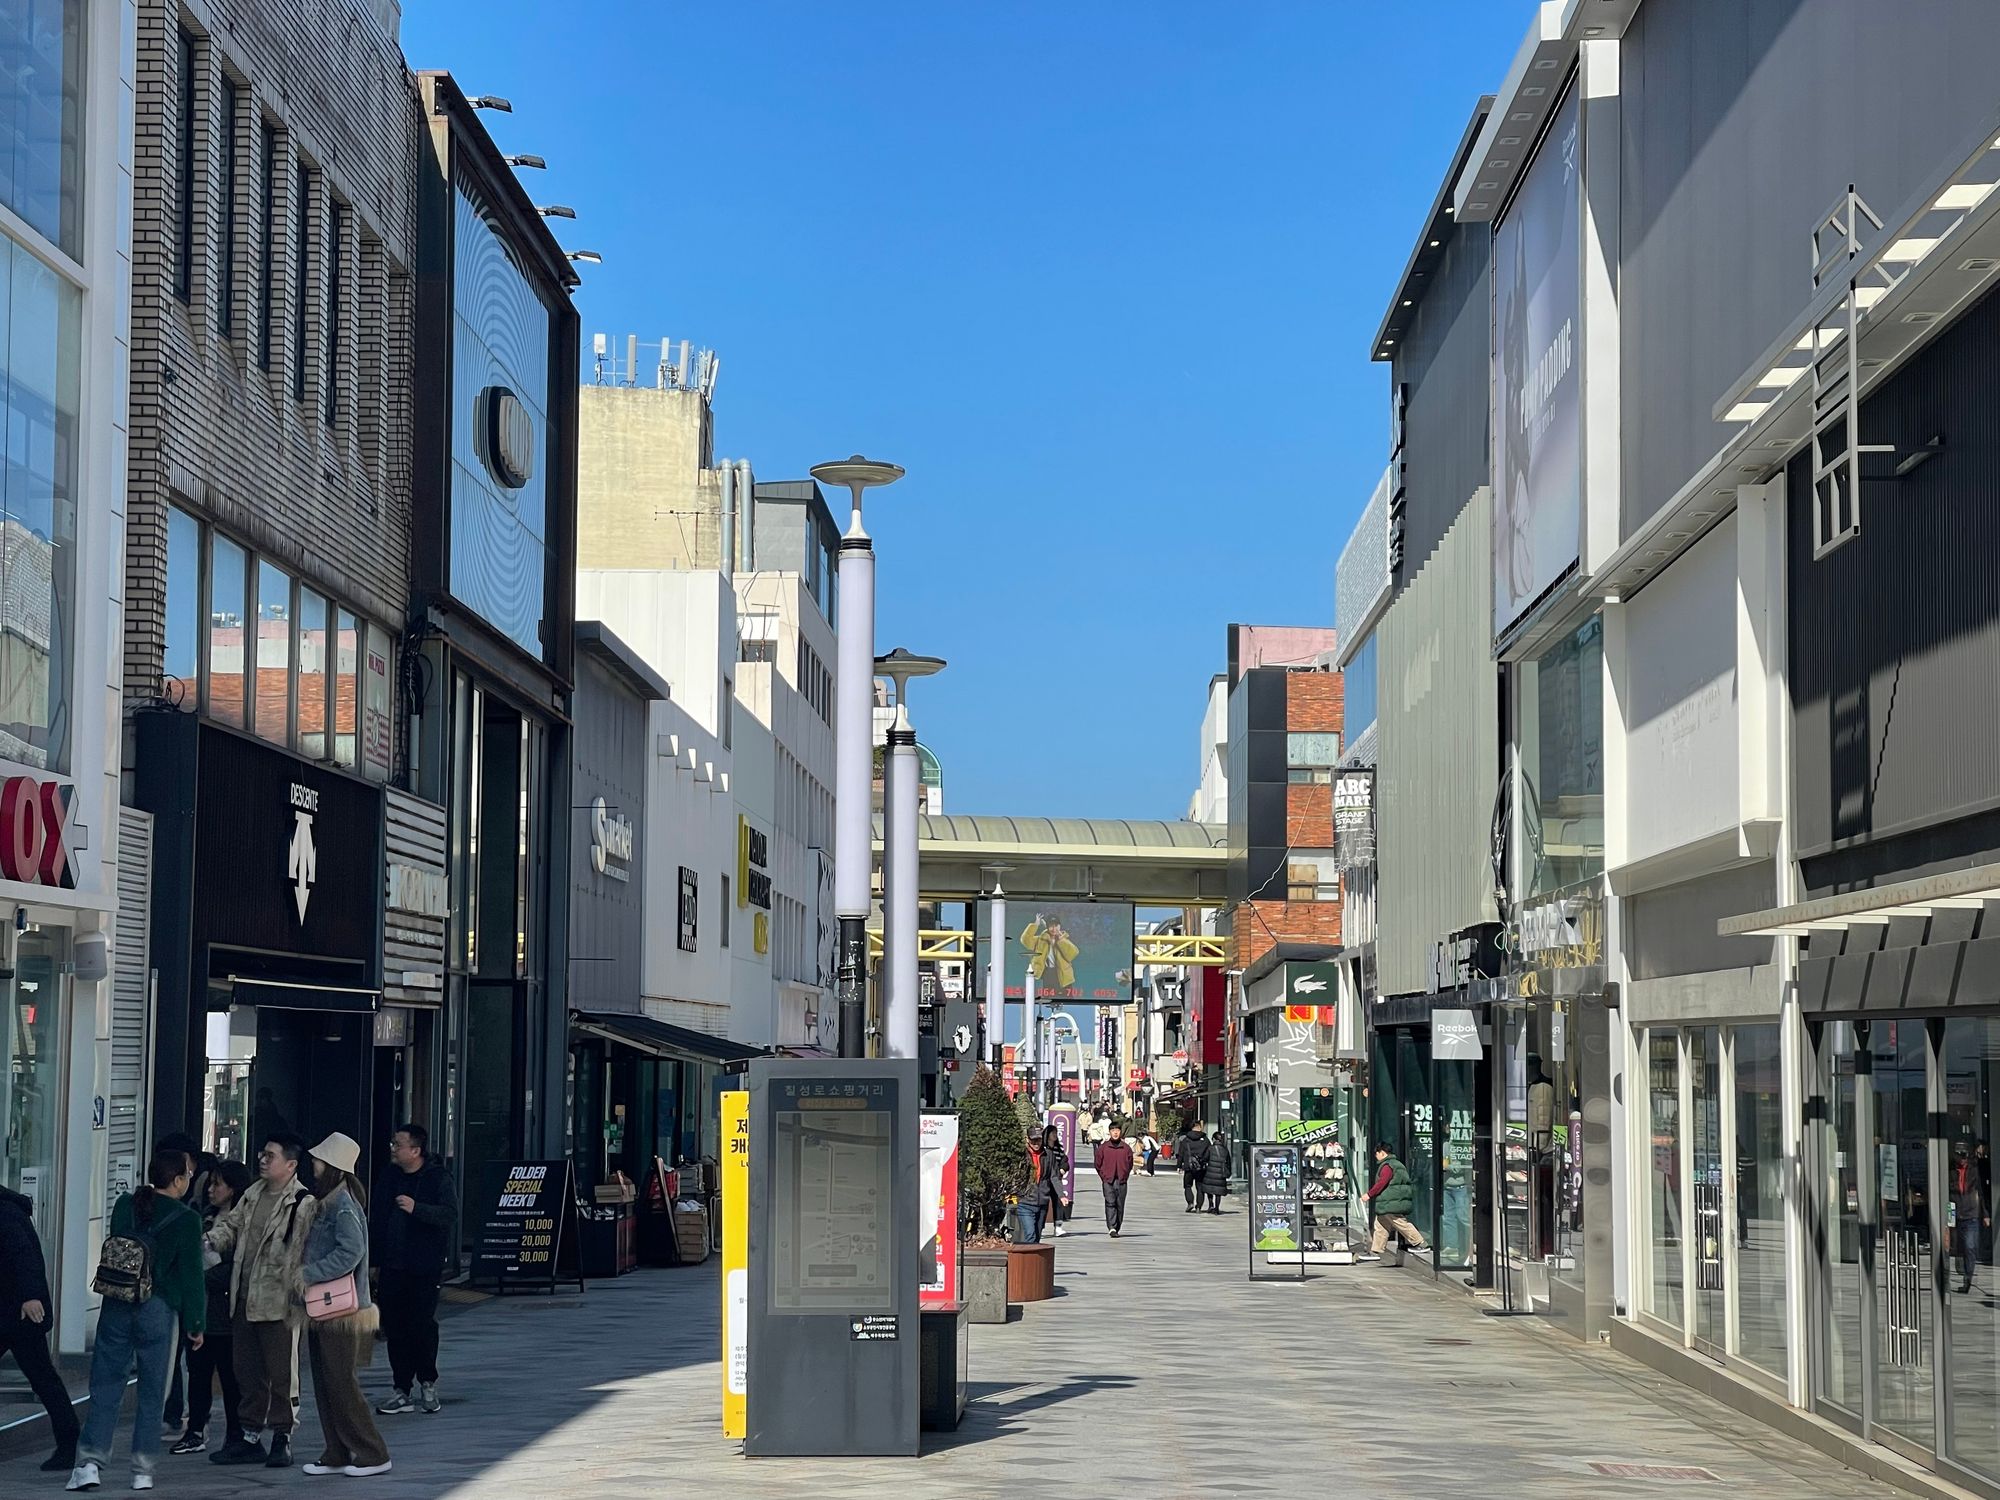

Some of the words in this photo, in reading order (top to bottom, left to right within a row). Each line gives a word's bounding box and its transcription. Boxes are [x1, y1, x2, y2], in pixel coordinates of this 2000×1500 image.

[1540, 318, 1571, 407] PADDING
[1334, 778, 1371, 796] ABC
[291, 782, 318, 812] DESCENTE
[1335, 795, 1371, 808] MART
[1335, 811, 1367, 819] GRAND
[1336, 817, 1364, 826] STAGE
[1437, 1023, 1478, 1033] Reebok
[784, 1084, 884, 1097] 칠성로쇼핑거리
[1279, 1120, 1308, 1140] GET
[509, 1166, 547, 1180] FOLDER
[1259, 1164, 1292, 1178] 풍성한
[503, 1180, 543, 1194] SPECIAL
[1266, 1179, 1287, 1192] 혜택
[498, 1194, 529, 1207] WEEK
[525, 1219, 553, 1231] 10,000
[522, 1235, 551, 1247] 20,000
[519, 1251, 549, 1263] 30,000
